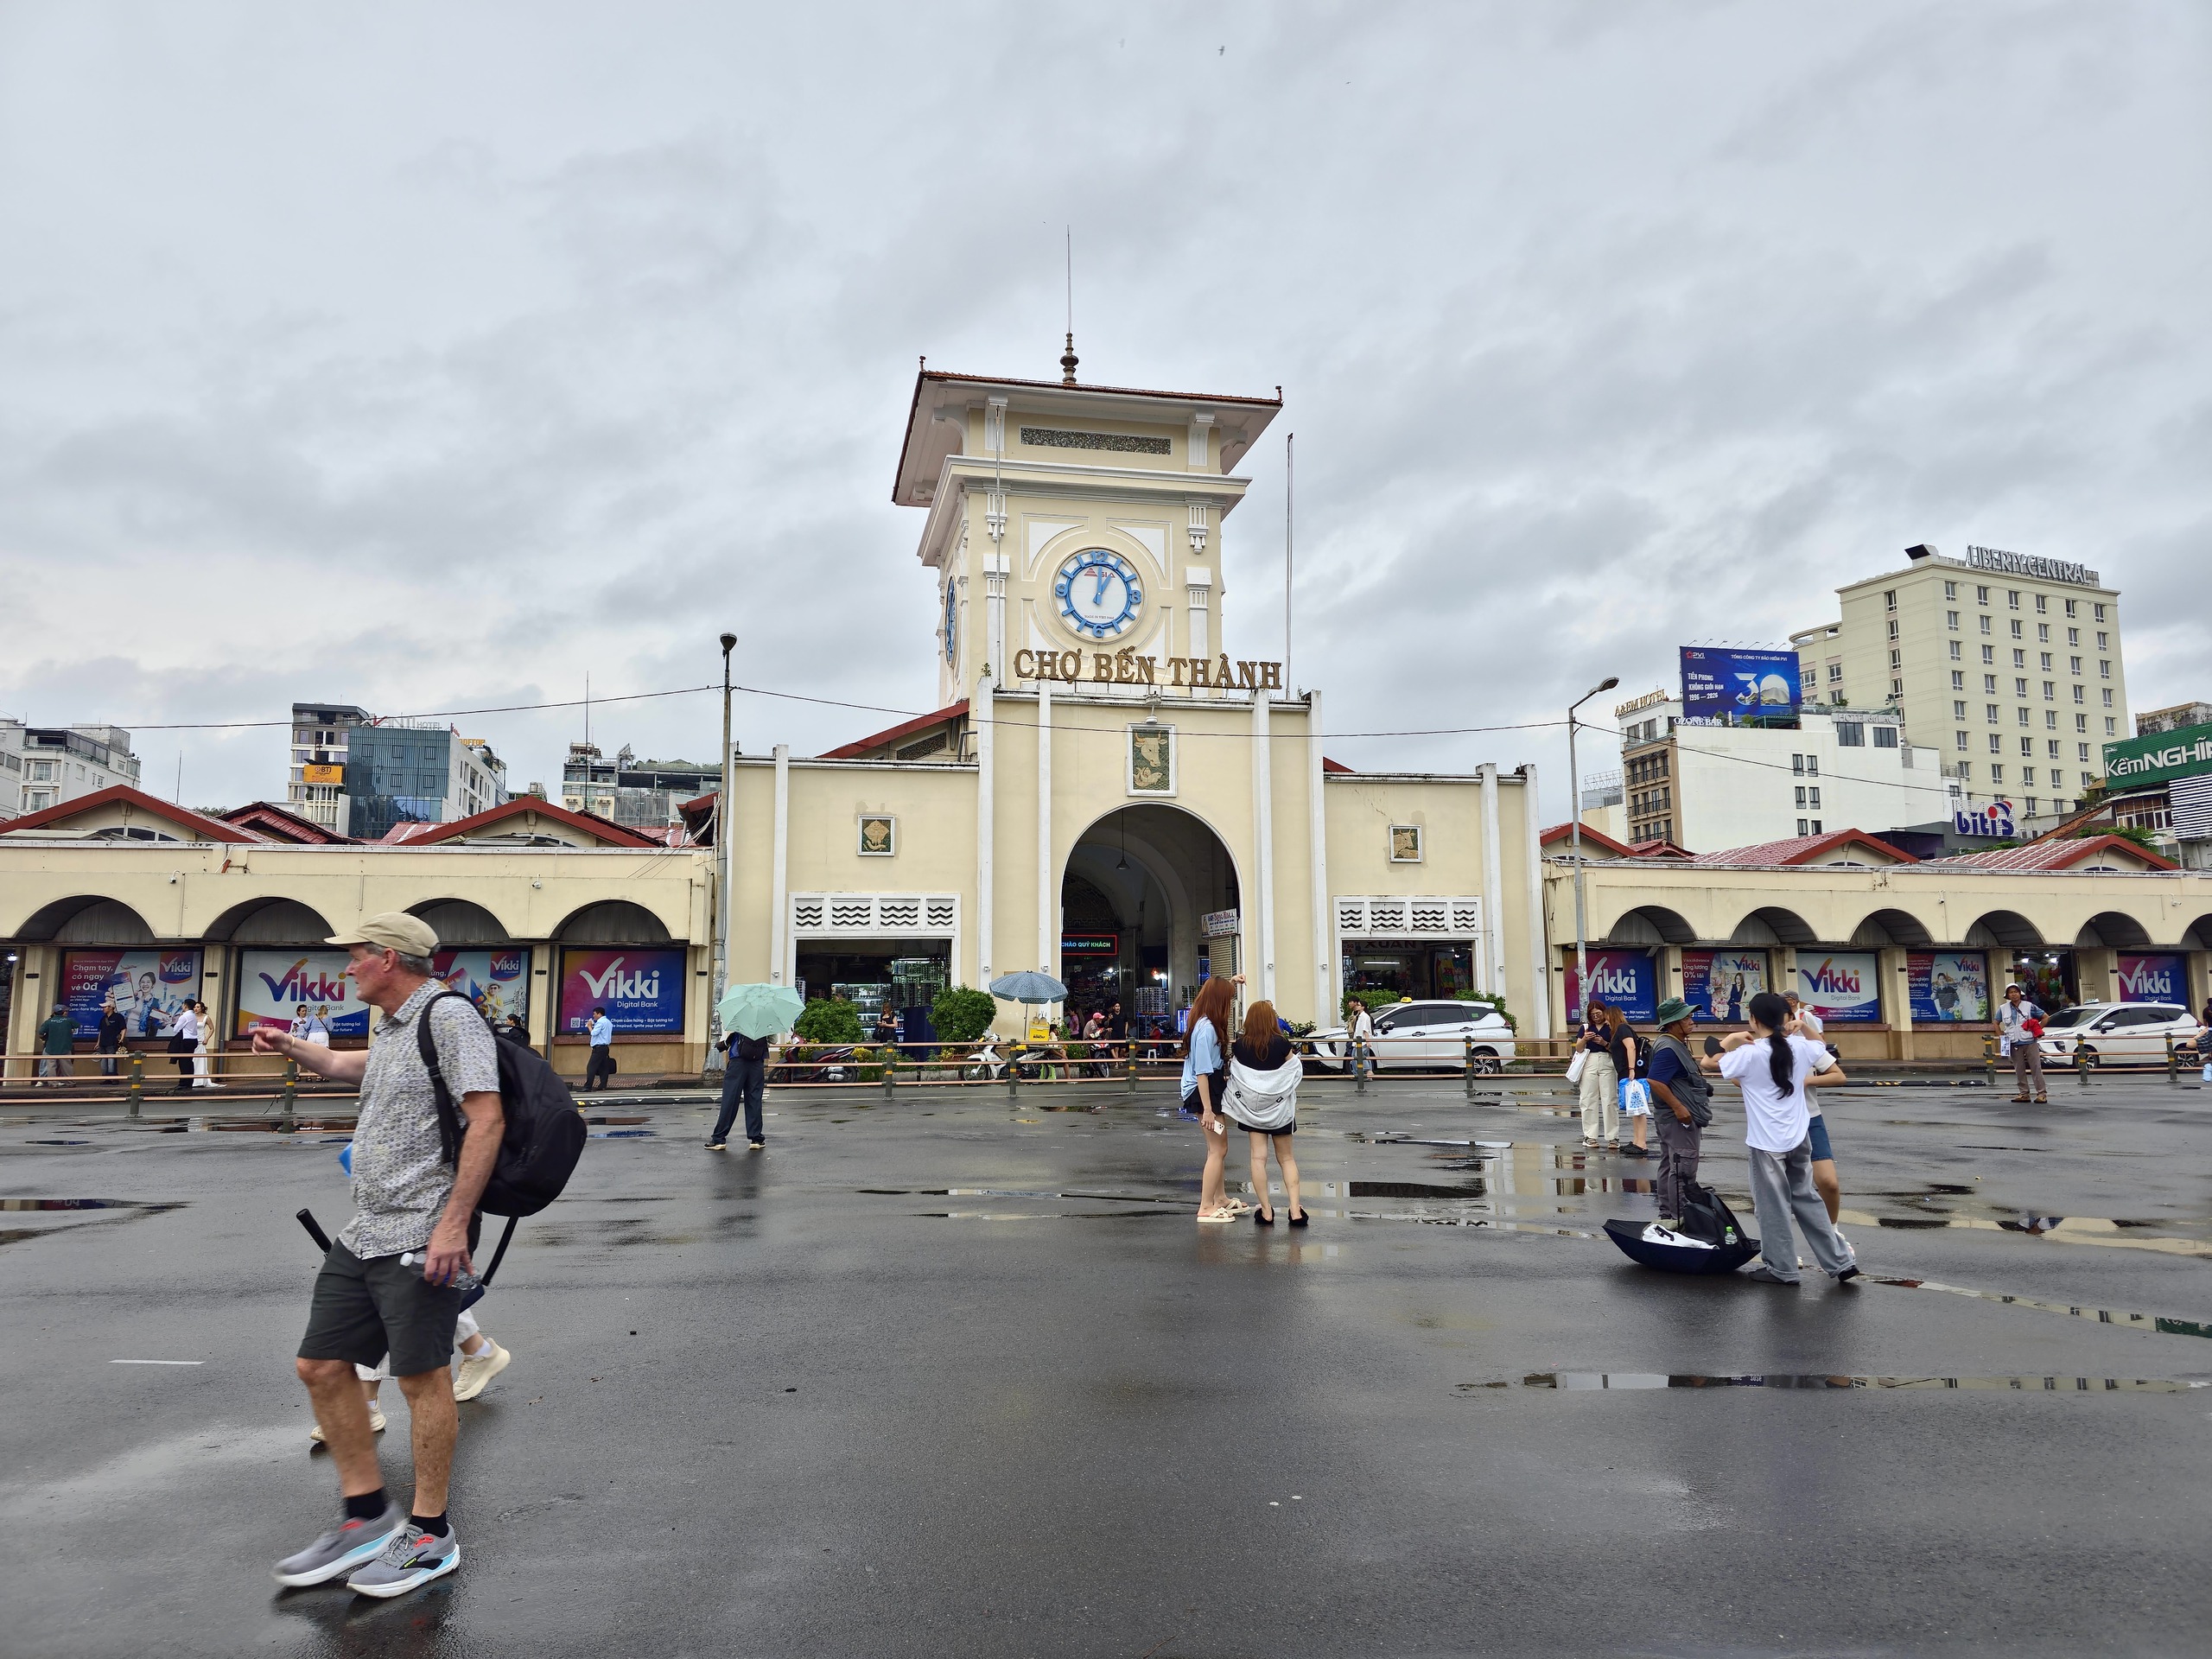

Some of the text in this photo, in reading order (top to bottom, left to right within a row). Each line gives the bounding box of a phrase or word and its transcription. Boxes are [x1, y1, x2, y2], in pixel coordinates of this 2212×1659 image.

[1090, 550, 1109, 565] 12
[1055, 583, 1067, 597] 9
[1130, 589, 1141, 605] 3
[1092, 625, 1104, 638] 6
[1014, 645, 1282, 690] CHỢ BẾN THÀNH
[1640, 689, 1665, 709] HOTEL
[1674, 716, 1723, 727] OZONE BAR
[161, 957, 191, 972] Vikki
[492, 956, 518, 970] Vikki
[1732, 954, 1760, 970] Vikki
[1954, 957, 1980, 971] Vikki
[258, 957, 347, 1001] Vikki
[579, 957, 659, 999] Vikki
[1574, 957, 1637, 993] Vikki
[1802, 957, 1860, 993] Vikki
[2118, 960, 2171, 994] Vikki
[83, 982, 99, 990] 0đ
[617, 1001, 639, 1009] Digital
